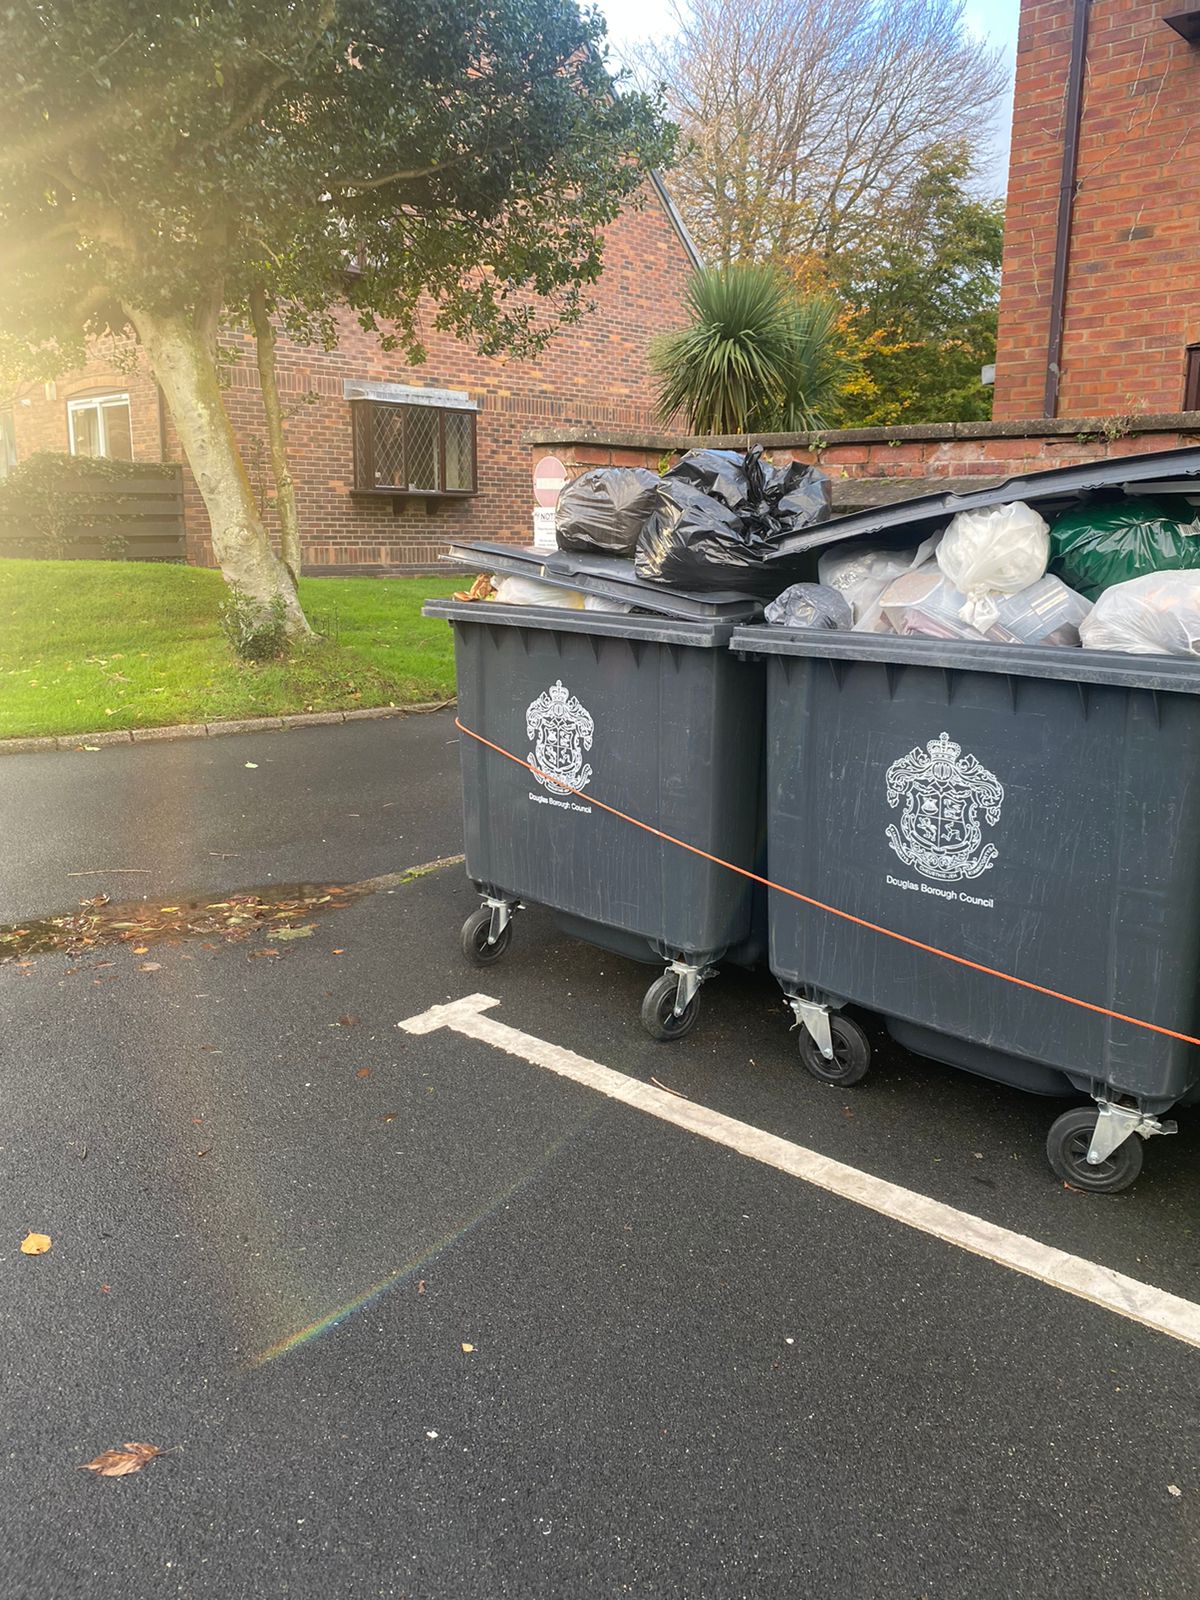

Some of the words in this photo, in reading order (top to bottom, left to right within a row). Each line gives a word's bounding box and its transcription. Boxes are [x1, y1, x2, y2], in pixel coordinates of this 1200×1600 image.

[528, 792, 548, 804] Douglas
[549, 797, 571, 810] Borough
[571, 802, 592, 814] Council
[886, 874, 919, 891] Douglas
[920, 883, 958, 900] Borough
[959, 892, 994, 908] Council
